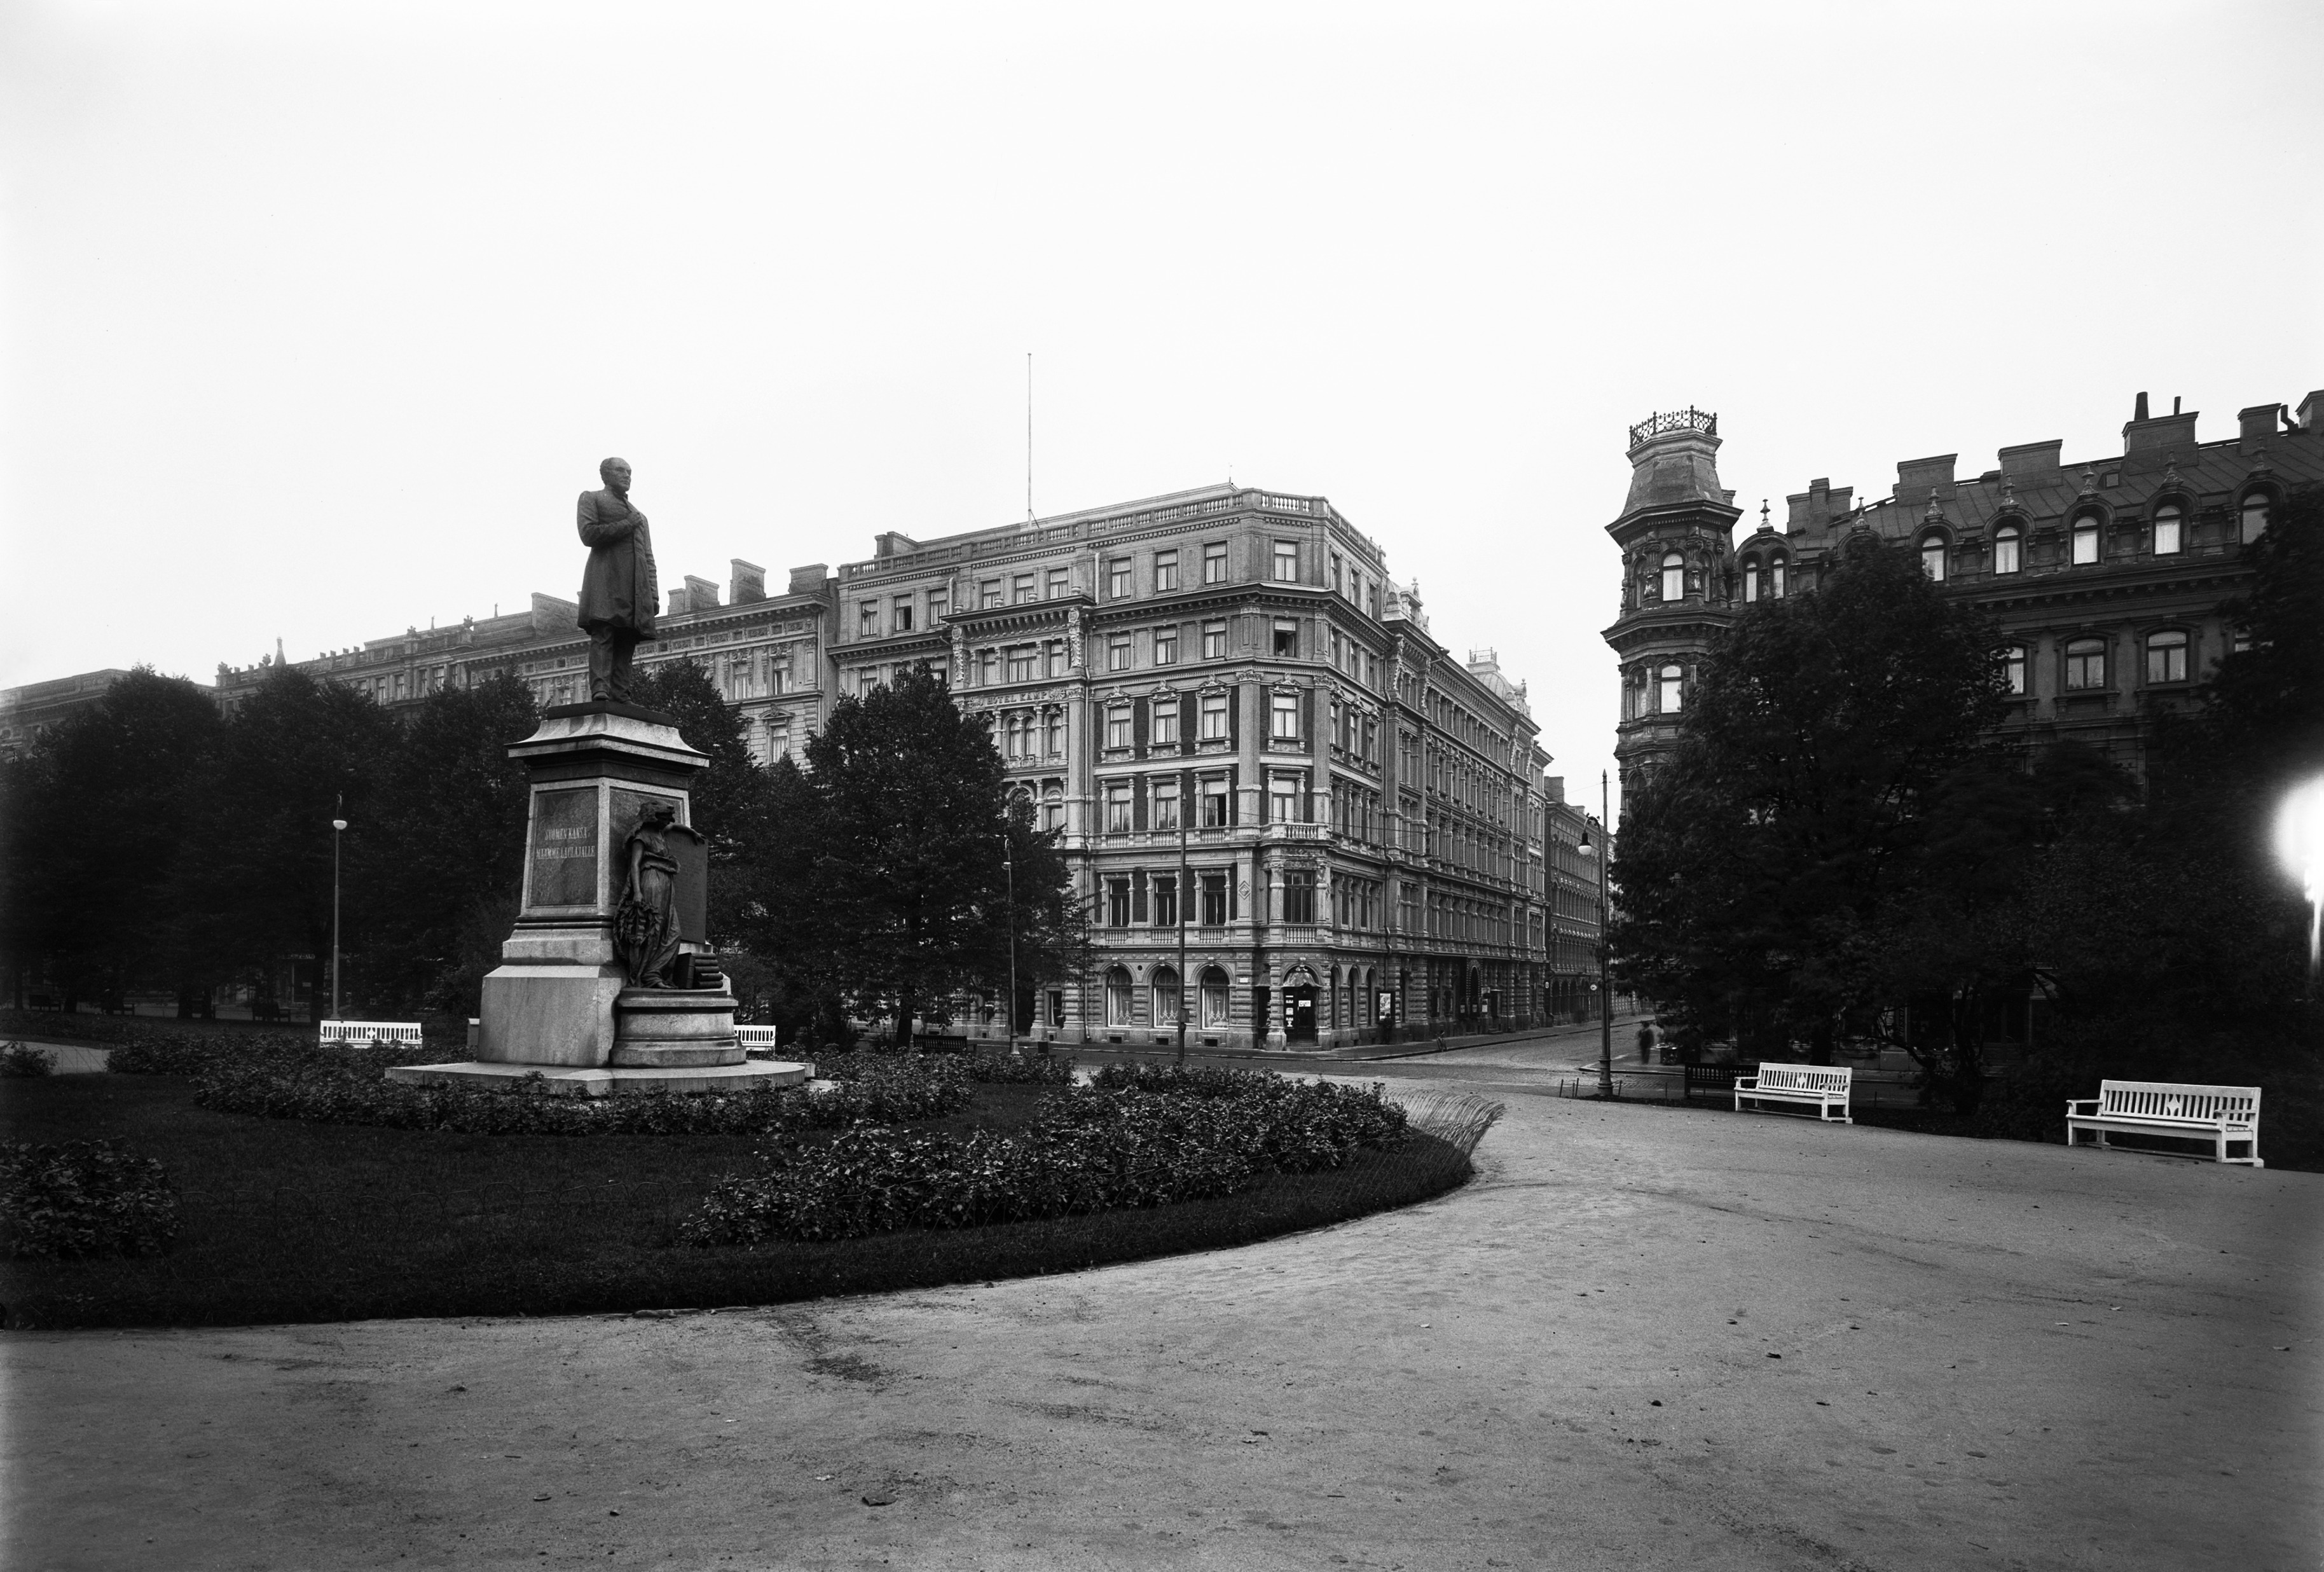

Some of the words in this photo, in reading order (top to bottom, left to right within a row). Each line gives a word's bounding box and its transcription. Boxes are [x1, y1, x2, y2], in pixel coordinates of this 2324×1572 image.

[987, 694, 1017, 705] HOTEL
[545, 828, 567, 841] SUOMEN
[568, 827, 587, 839] KANSA
[536, 847, 560, 860] MAAMME
[561, 845, 595, 858] LAULAJALLE
